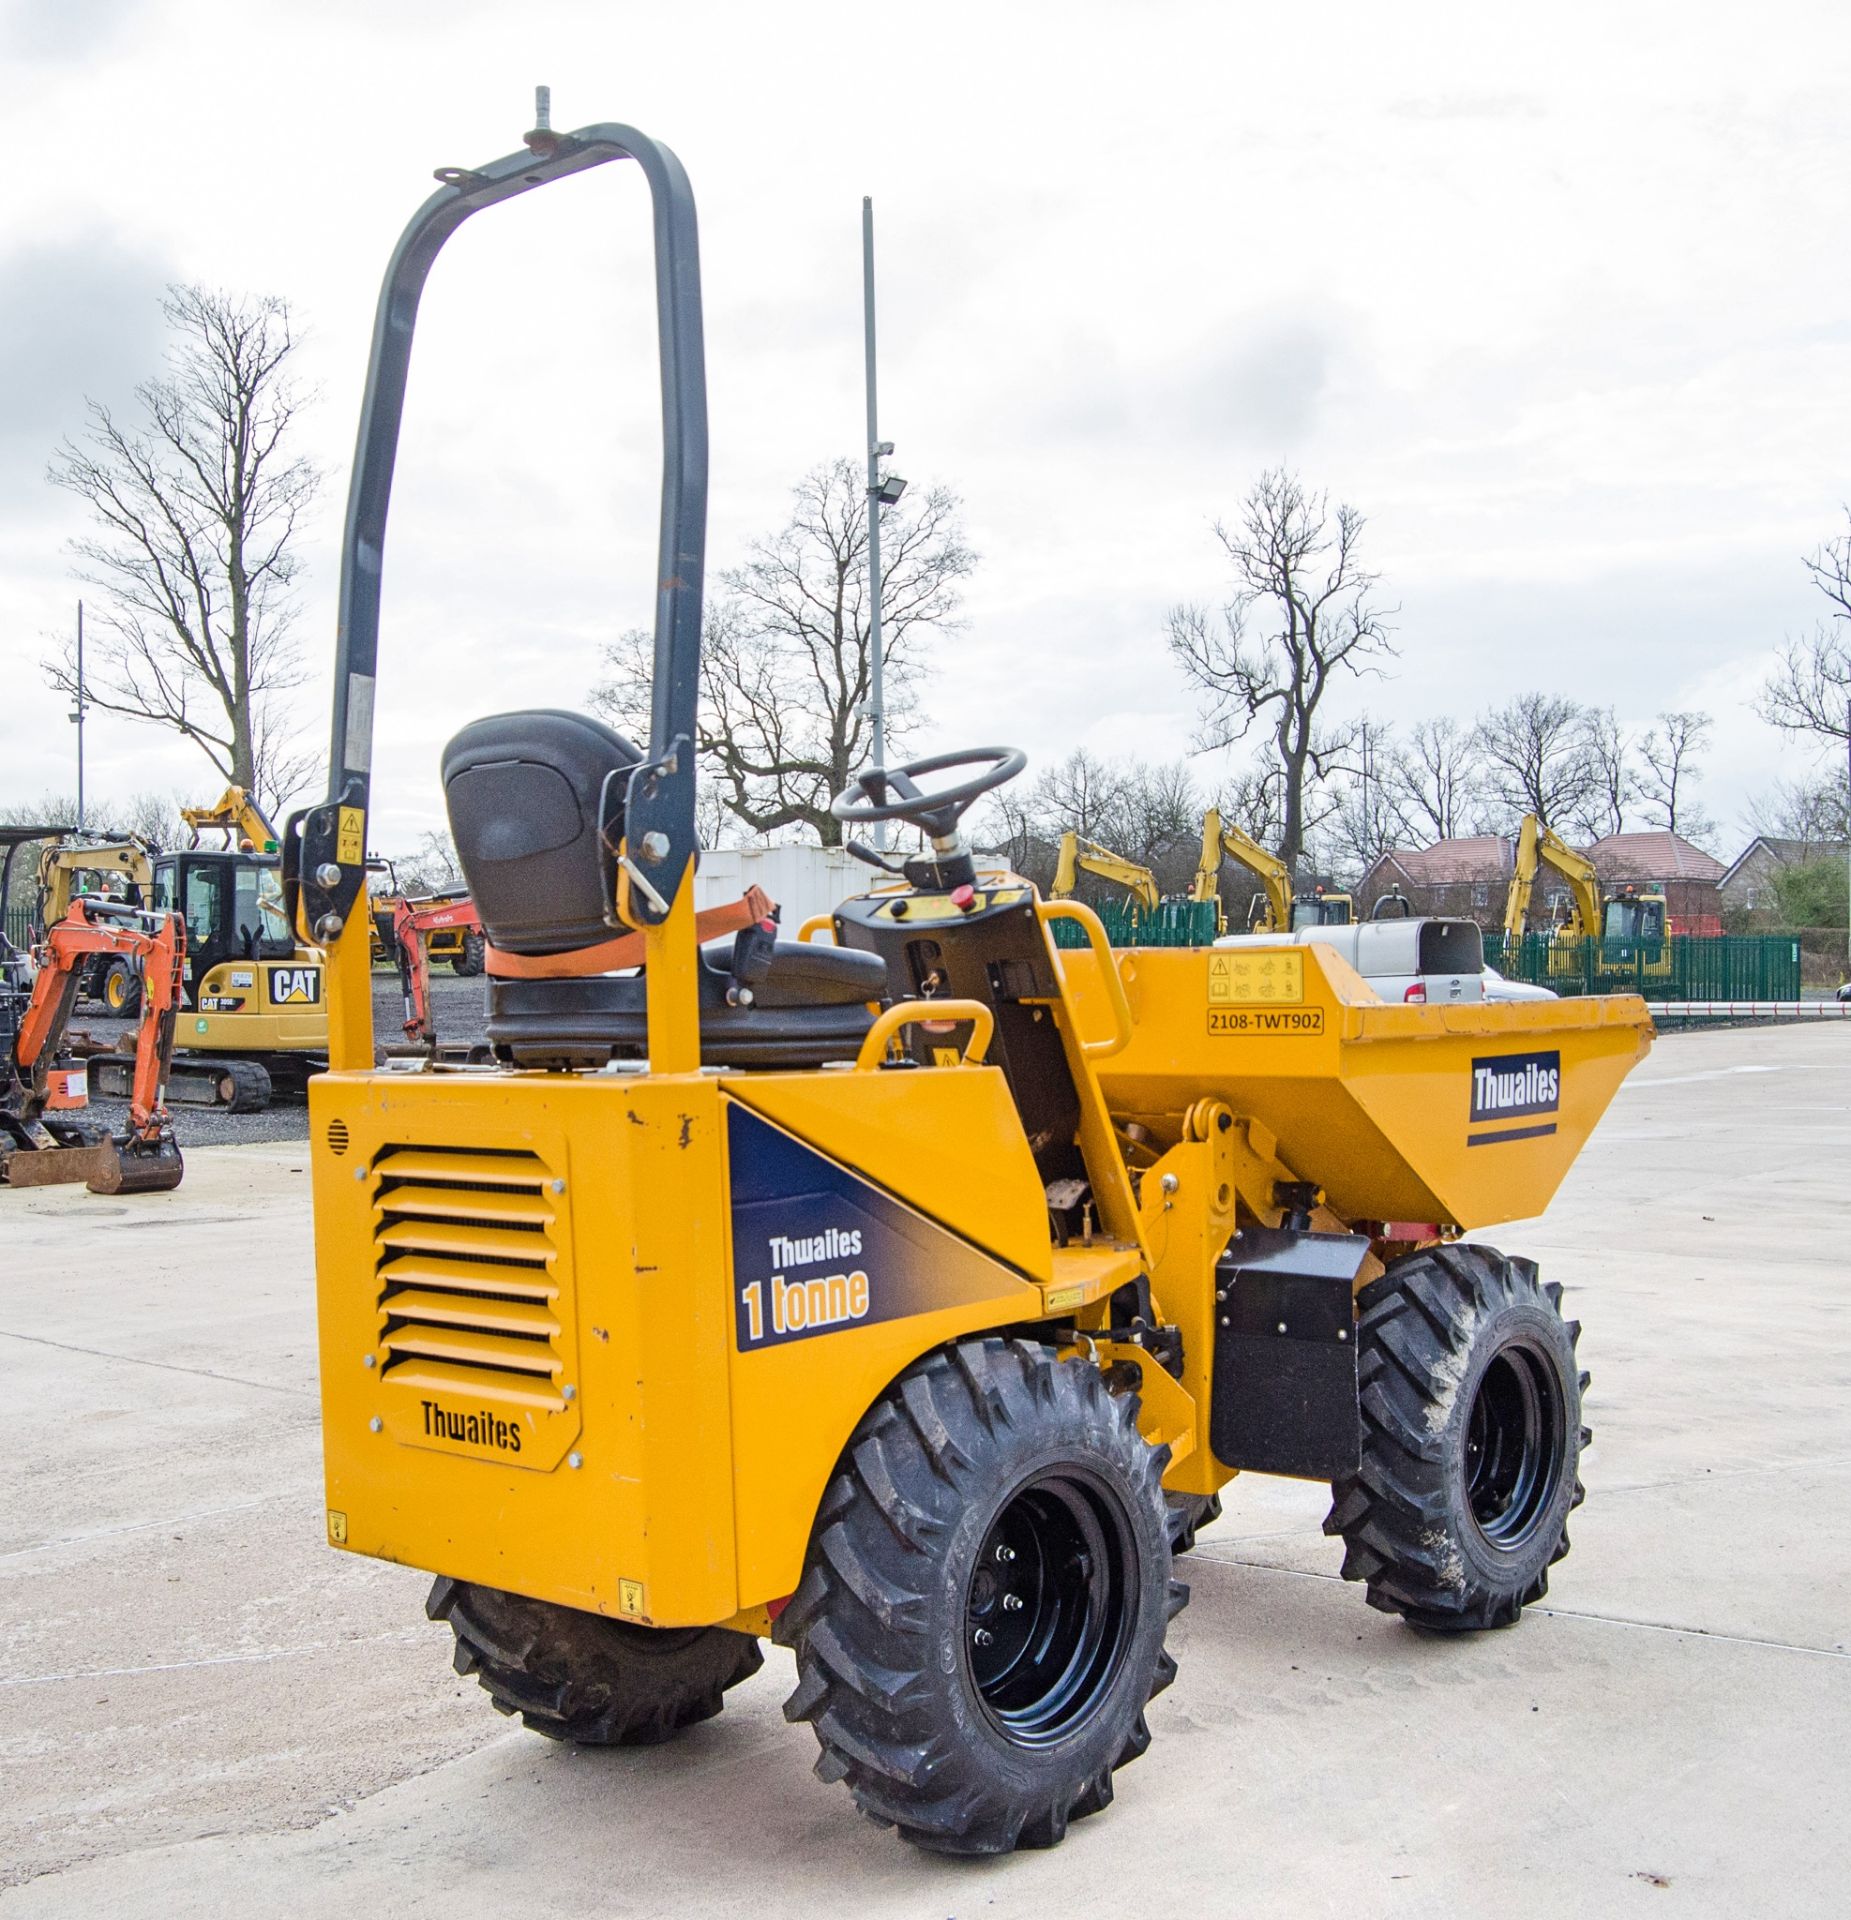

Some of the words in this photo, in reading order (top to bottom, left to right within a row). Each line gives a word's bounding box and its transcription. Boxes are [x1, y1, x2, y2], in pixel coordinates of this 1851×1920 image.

[201, 998, 218, 1010] CAT
[273, 970, 316, 1003] CAT
[1210, 1013, 1321, 1029] 2108-TWT902
[1475, 1063, 1558, 1111] Thwaites
[769, 1228, 862, 1269] Thwaites
[742, 1280, 763, 1341] 1
[771, 1270, 869, 1334] tonne
[421, 1400, 521, 1453] Thwaites
